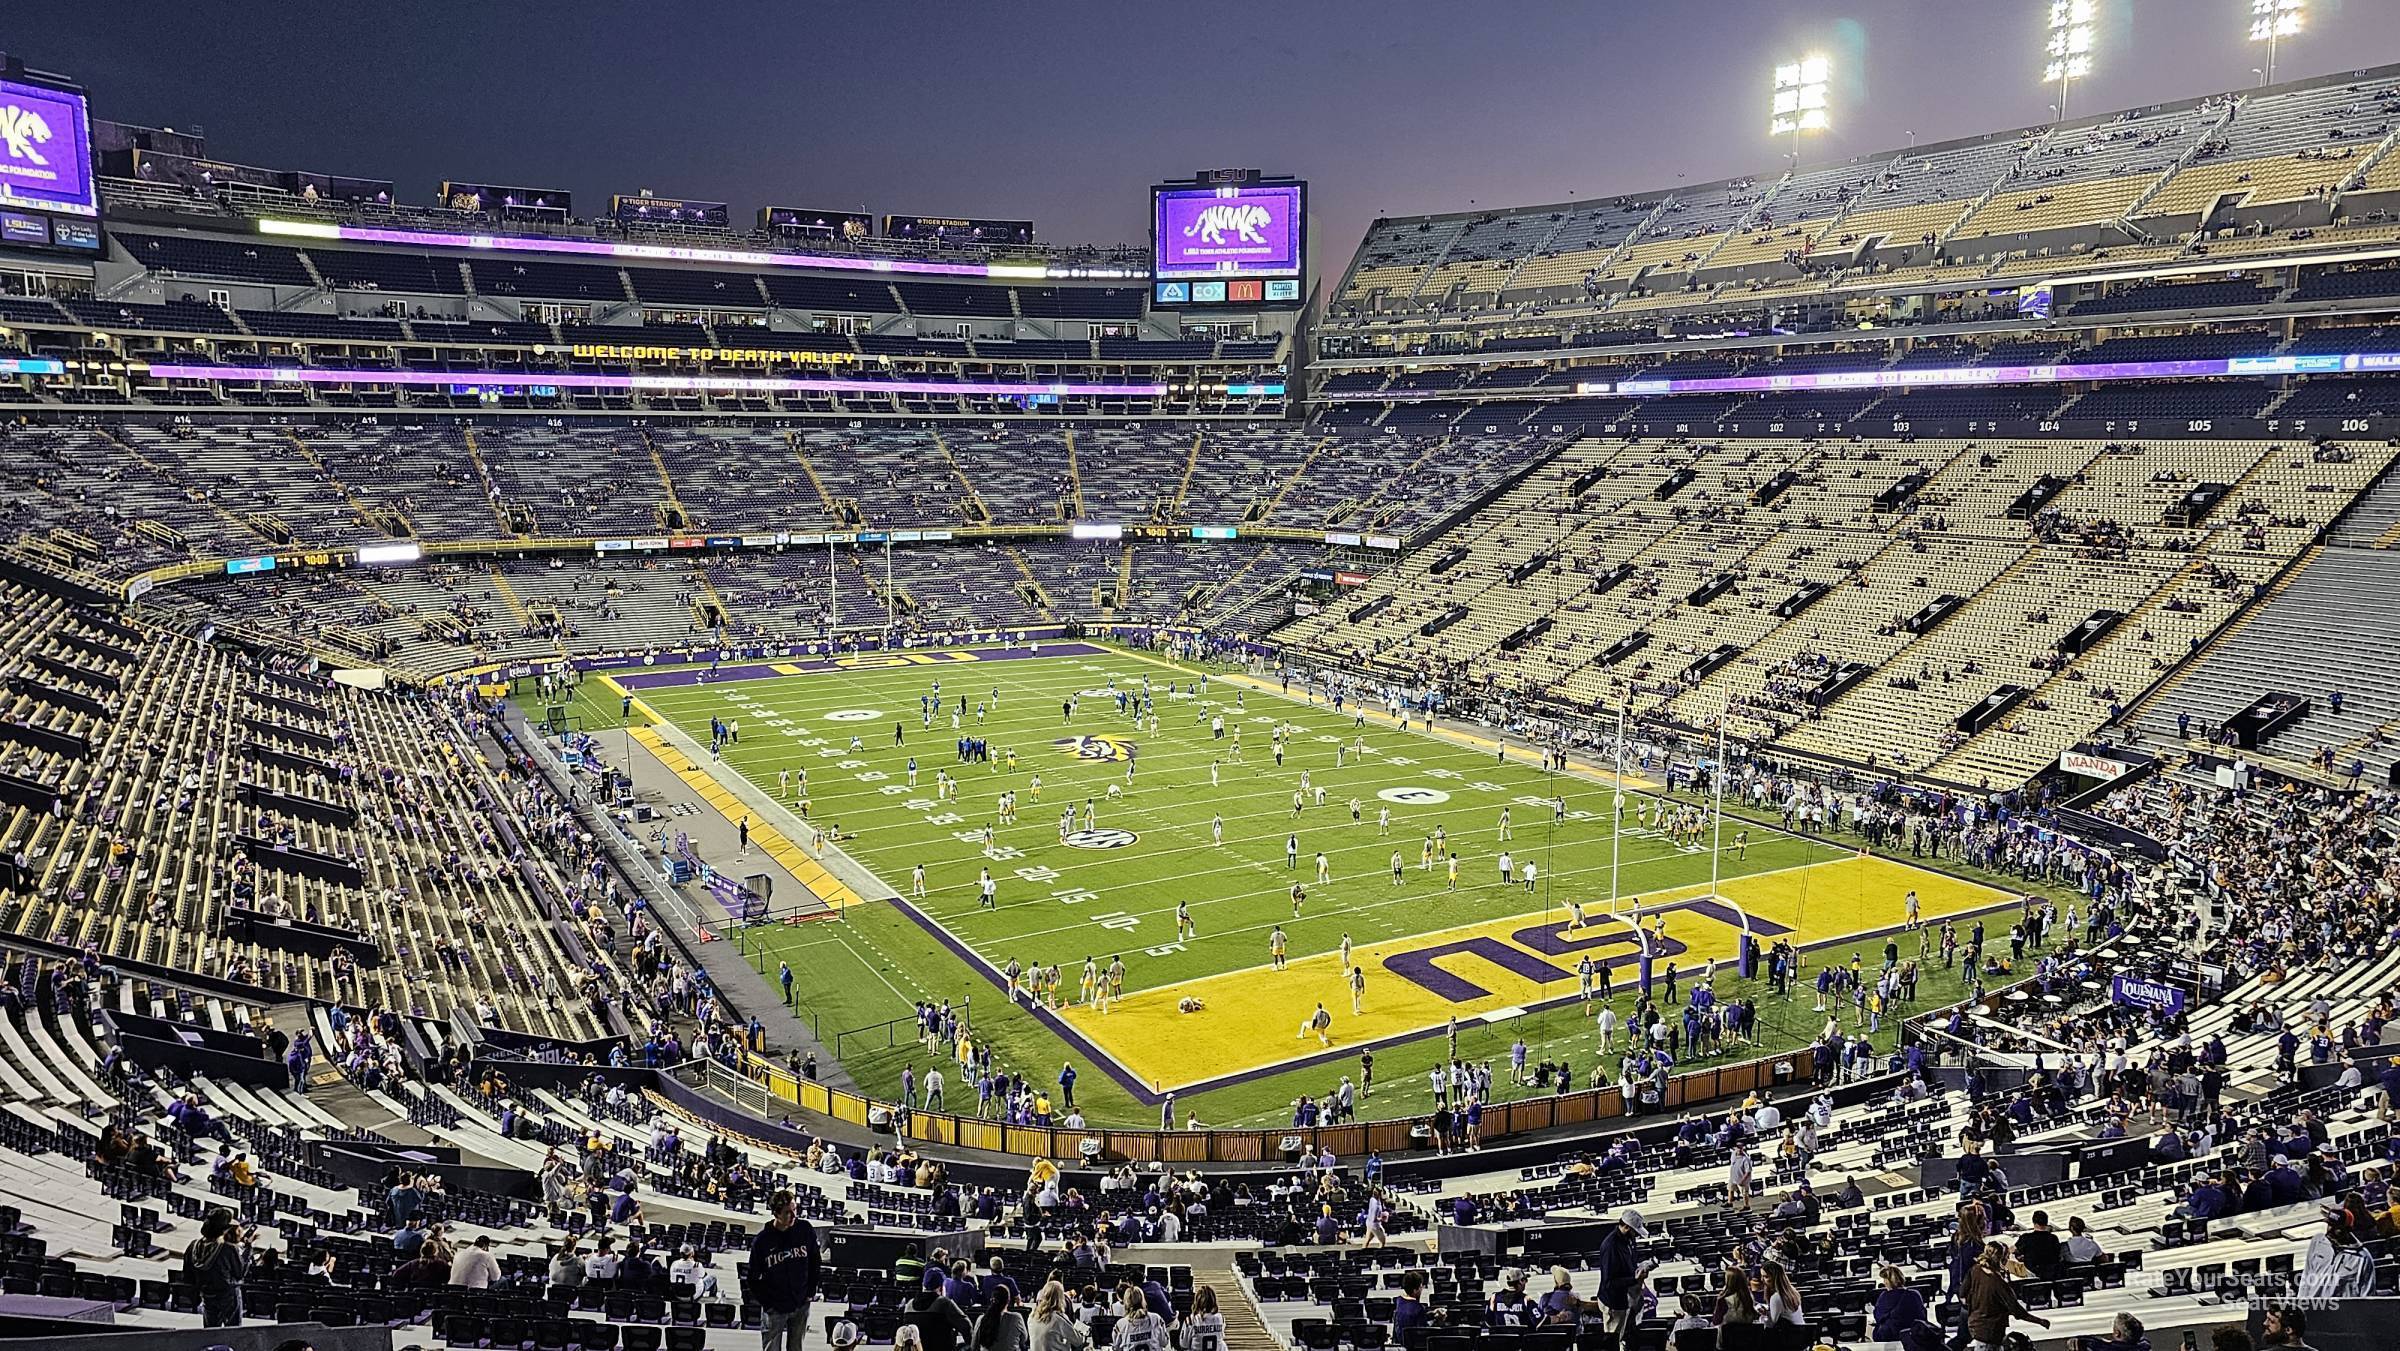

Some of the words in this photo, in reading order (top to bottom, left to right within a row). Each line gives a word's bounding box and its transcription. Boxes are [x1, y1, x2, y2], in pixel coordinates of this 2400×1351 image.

[1209, 168, 1247, 183] LSU
[628, 198, 650, 206] TIGER
[650, 200, 682, 208] STADIUM
[4, 218, 25, 229] LSU
[1194, 286, 1224, 297] COX
[573, 344, 680, 360] WELCOME
[688, 347, 713, 361] TO
[719, 348, 782, 362] DEATH
[789, 351, 855, 364] VALLEY
[174, 416, 191, 424] 414
[361, 417, 377, 425] 415
[548, 418, 563, 427] 416
[848, 421, 862, 429] 418
[992, 422, 1005, 430] 419
[1384, 426, 1397, 434] 422
[1485, 425, 1497, 434] 423
[1552, 425, 1563, 433] 424
[1604, 424, 1617, 433] 100
[1676, 424, 1688, 433] 101
[1769, 423, 1784, 432] 102
[1893, 422, 1909, 432] 103
[2039, 422, 2060, 432] 104
[2188, 420, 2212, 432] 105
[2341, 419, 2369, 432] 106
[304, 553, 329, 564] 90:00
[768, 650, 980, 676] LSU
[2067, 756, 2117, 776] MANDA
[1012, 865, 1061, 884] 20
[1050, 887, 1099, 905] 15
[1088, 911, 1141, 930] 10
[1144, 943, 1188, 957] 5
[1382, 899, 1796, 1004] LSU
[2121, 979, 2175, 1006] LOUISIANA
[538, 1041, 553, 1050] OF
[2319, 1037, 2328, 1047] 33
[870, 1168, 875, 1179] 3
[887, 1170, 893, 1180] 9
[1145, 1224, 1153, 1236] 3
